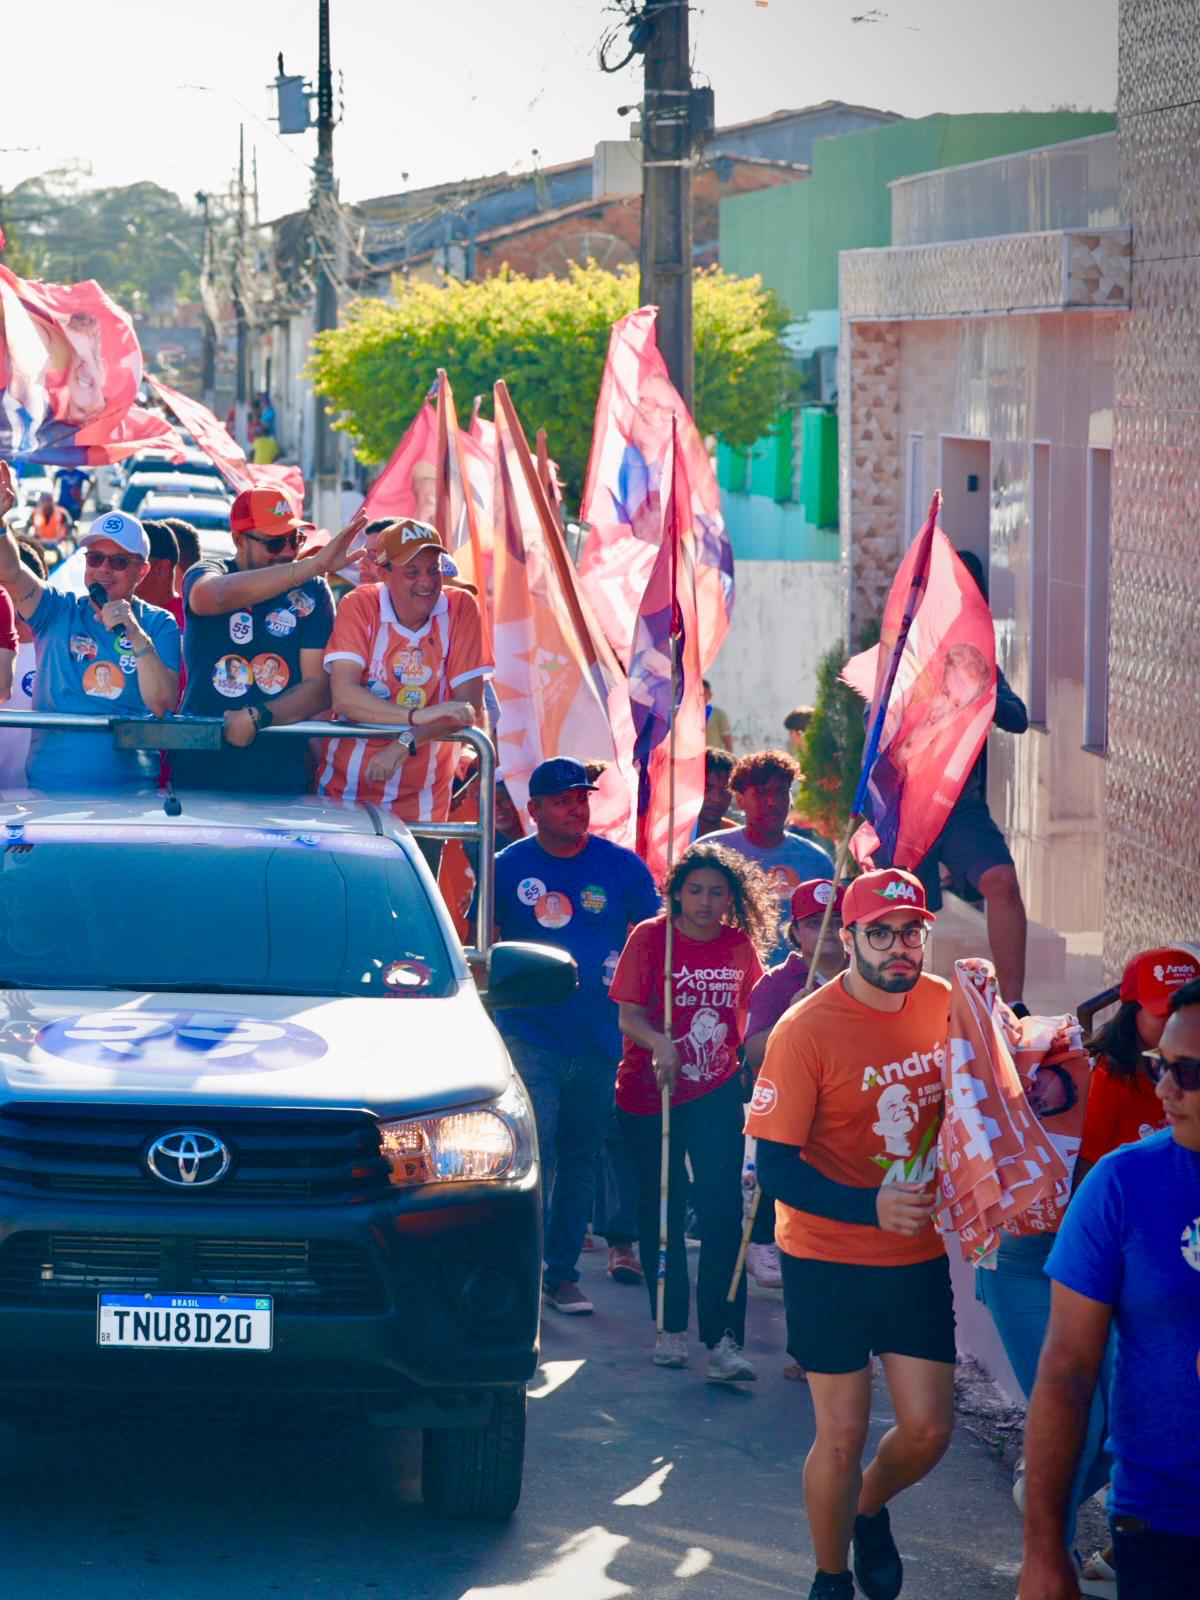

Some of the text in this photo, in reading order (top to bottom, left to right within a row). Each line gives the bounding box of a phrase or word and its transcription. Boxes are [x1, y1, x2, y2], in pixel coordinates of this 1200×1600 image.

[105, 519, 120, 530] 55
[232, 622, 250, 635] 55
[119, 655, 137, 668] 55
[525, 885, 539, 900] 55
[695, 966, 744, 981] ROGÉRIO
[696, 981, 707, 991] O
[675, 991, 697, 1007] de
[64, 1012, 287, 1042] 55
[861, 1041, 945, 1092] André
[753, 1085, 774, 1104] 55
[172, 1298, 199, 1307] BRASIL
[114, 1311, 251, 1344] TNU8D20
[102, 1332, 110, 1342] BR
